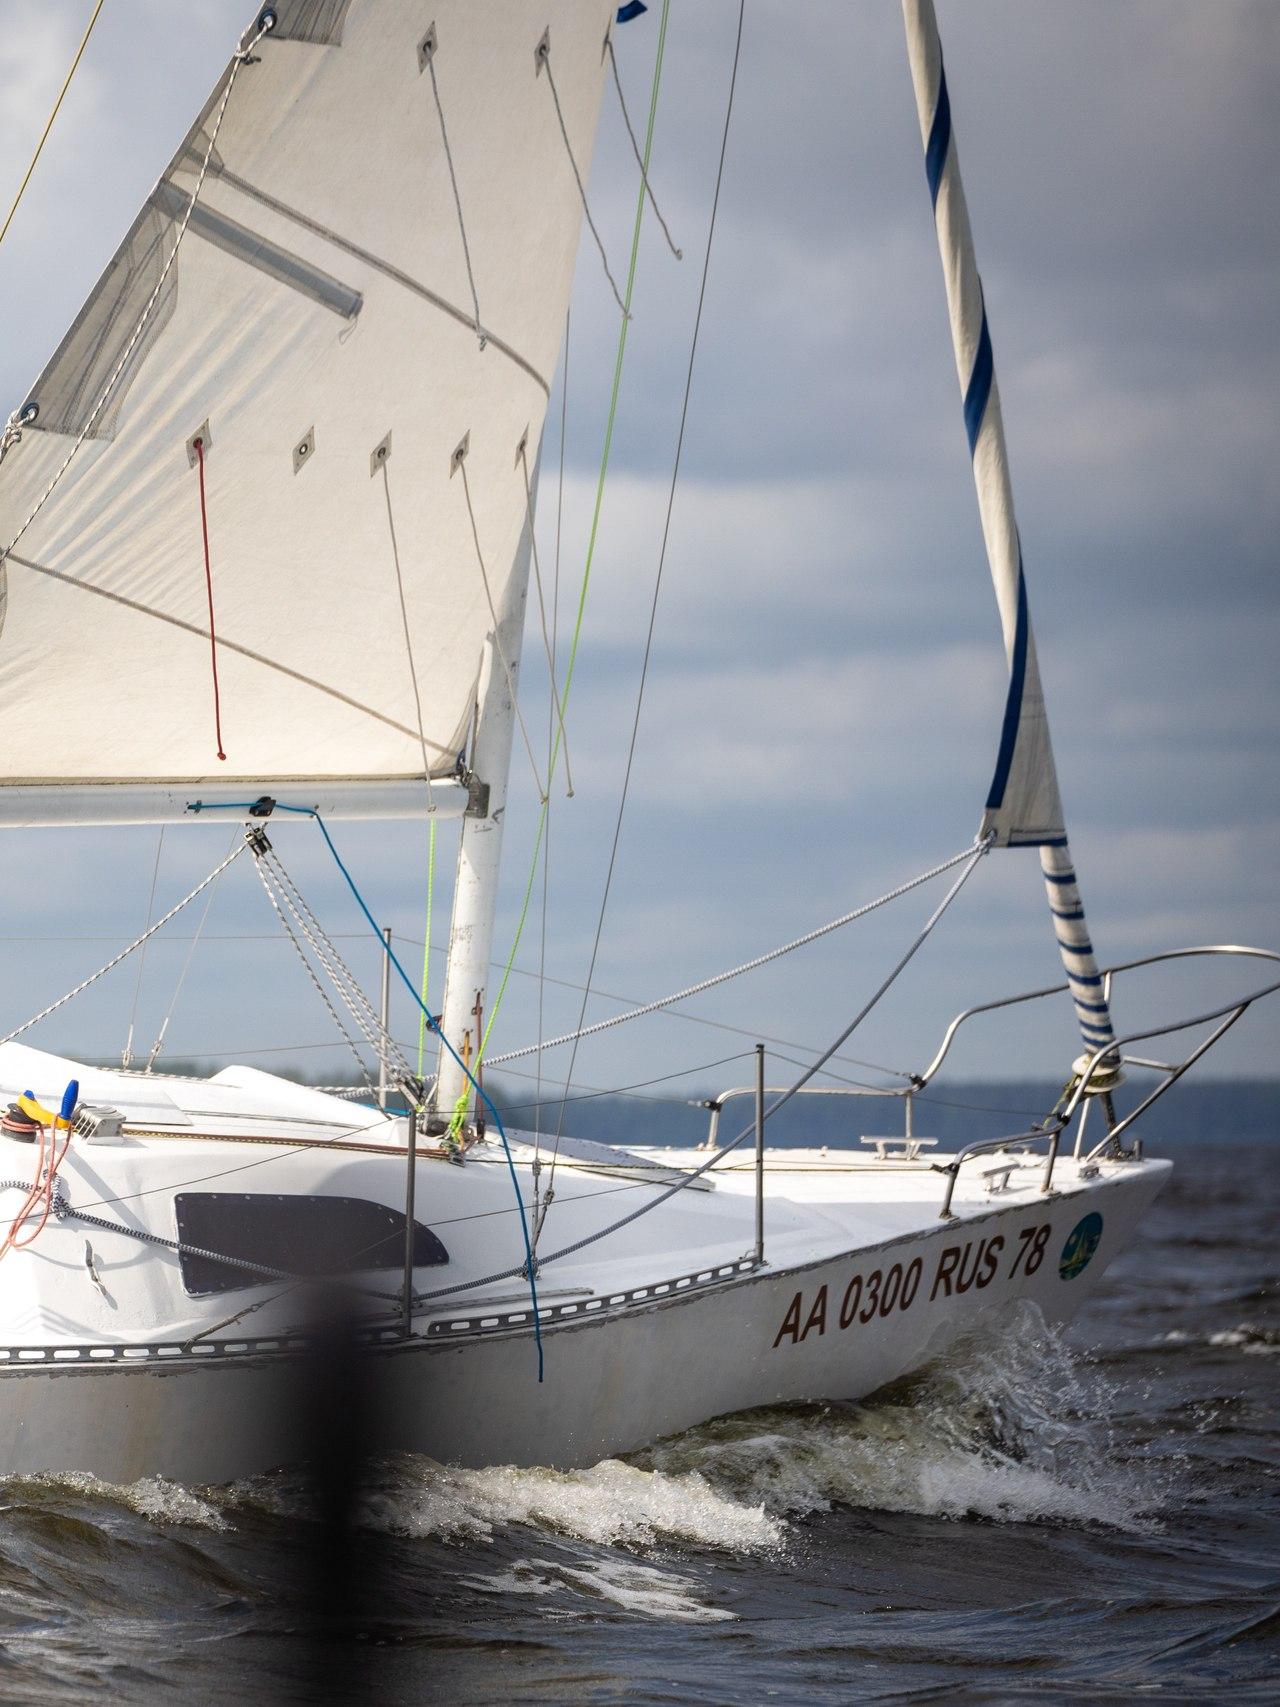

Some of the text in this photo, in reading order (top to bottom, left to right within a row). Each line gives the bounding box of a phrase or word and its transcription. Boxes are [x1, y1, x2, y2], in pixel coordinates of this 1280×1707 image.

[772, 1223, 1052, 1348] AA 0300 RUS 78
